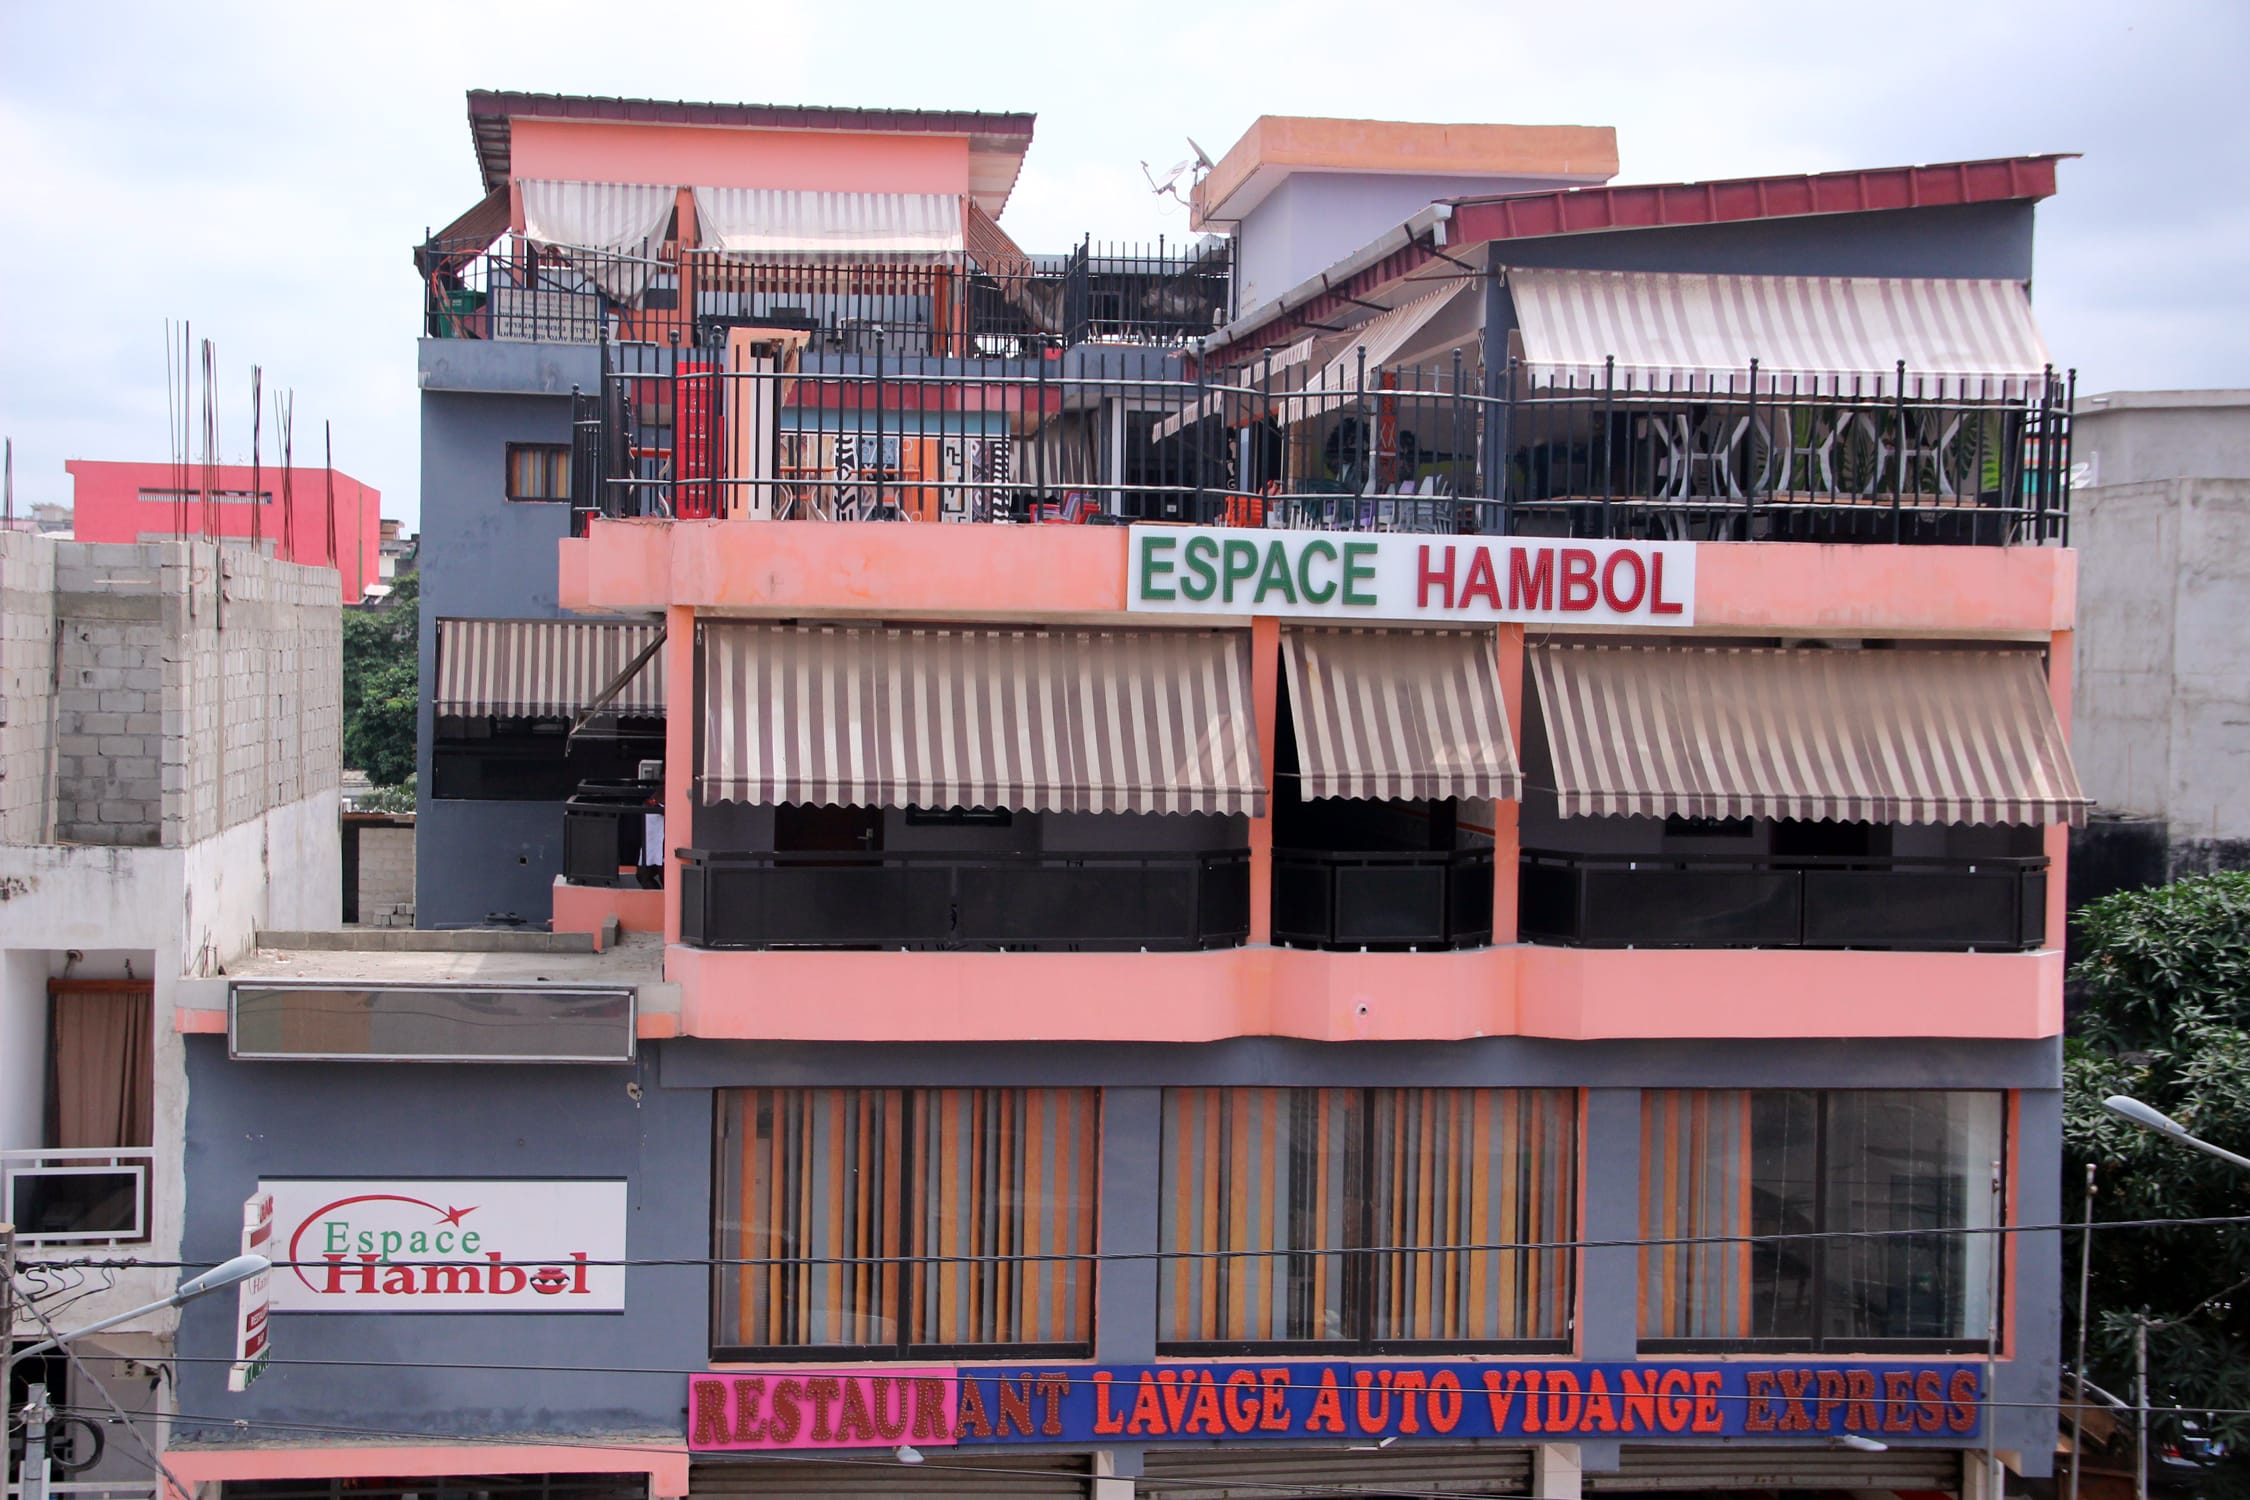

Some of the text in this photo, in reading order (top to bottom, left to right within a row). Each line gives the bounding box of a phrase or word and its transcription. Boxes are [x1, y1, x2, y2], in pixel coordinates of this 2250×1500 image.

[1141, 535, 1684, 615] ESPACE HAMBOL
[322, 1221, 481, 1263] Espace
[694, 1367, 1977, 1444] RESTAURANT LAVAGE AUTO VIDANGE EXPRESS
